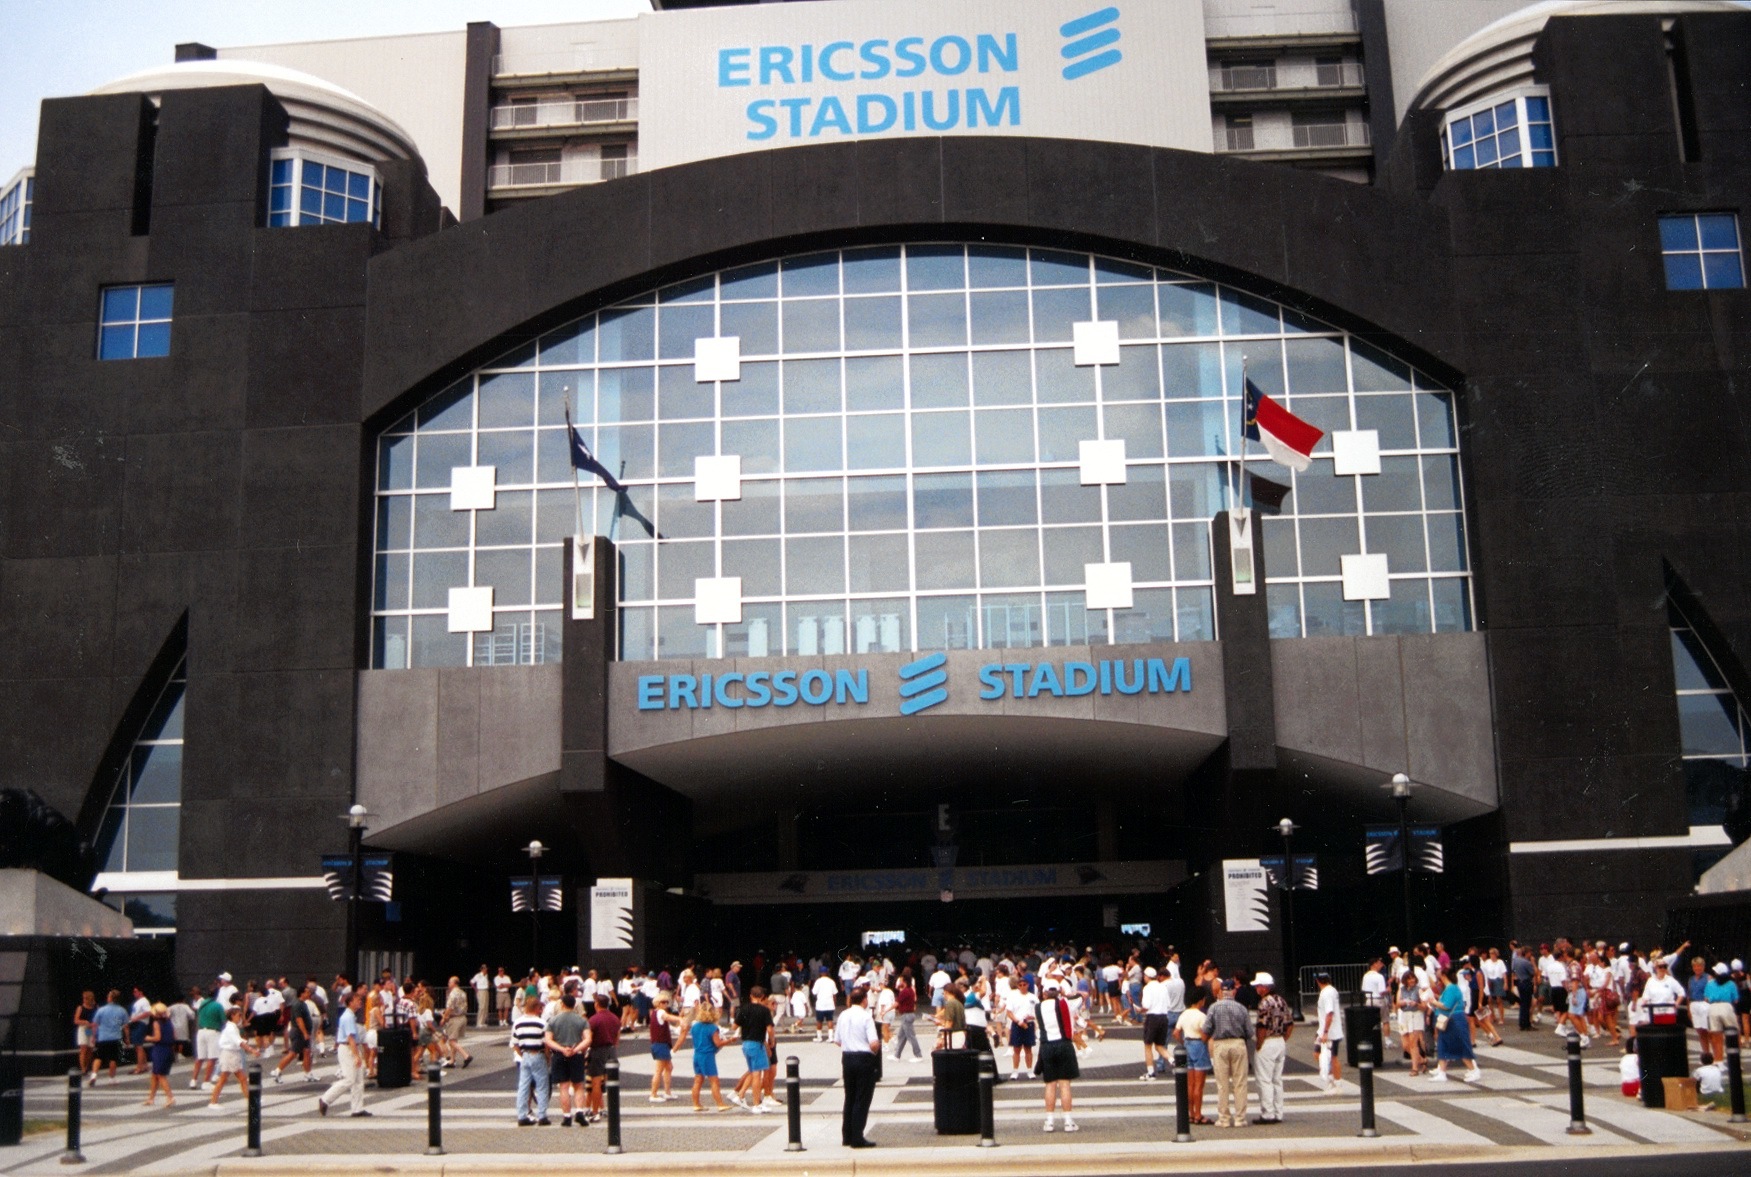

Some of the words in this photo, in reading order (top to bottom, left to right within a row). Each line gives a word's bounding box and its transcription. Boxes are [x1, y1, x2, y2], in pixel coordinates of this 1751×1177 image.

[718, 33, 1018, 87] ERICSSON
[747, 86, 1020, 140] STADIUM
[638, 669, 868, 709] ERICSSON
[980, 658, 1191, 699] STADIUM
